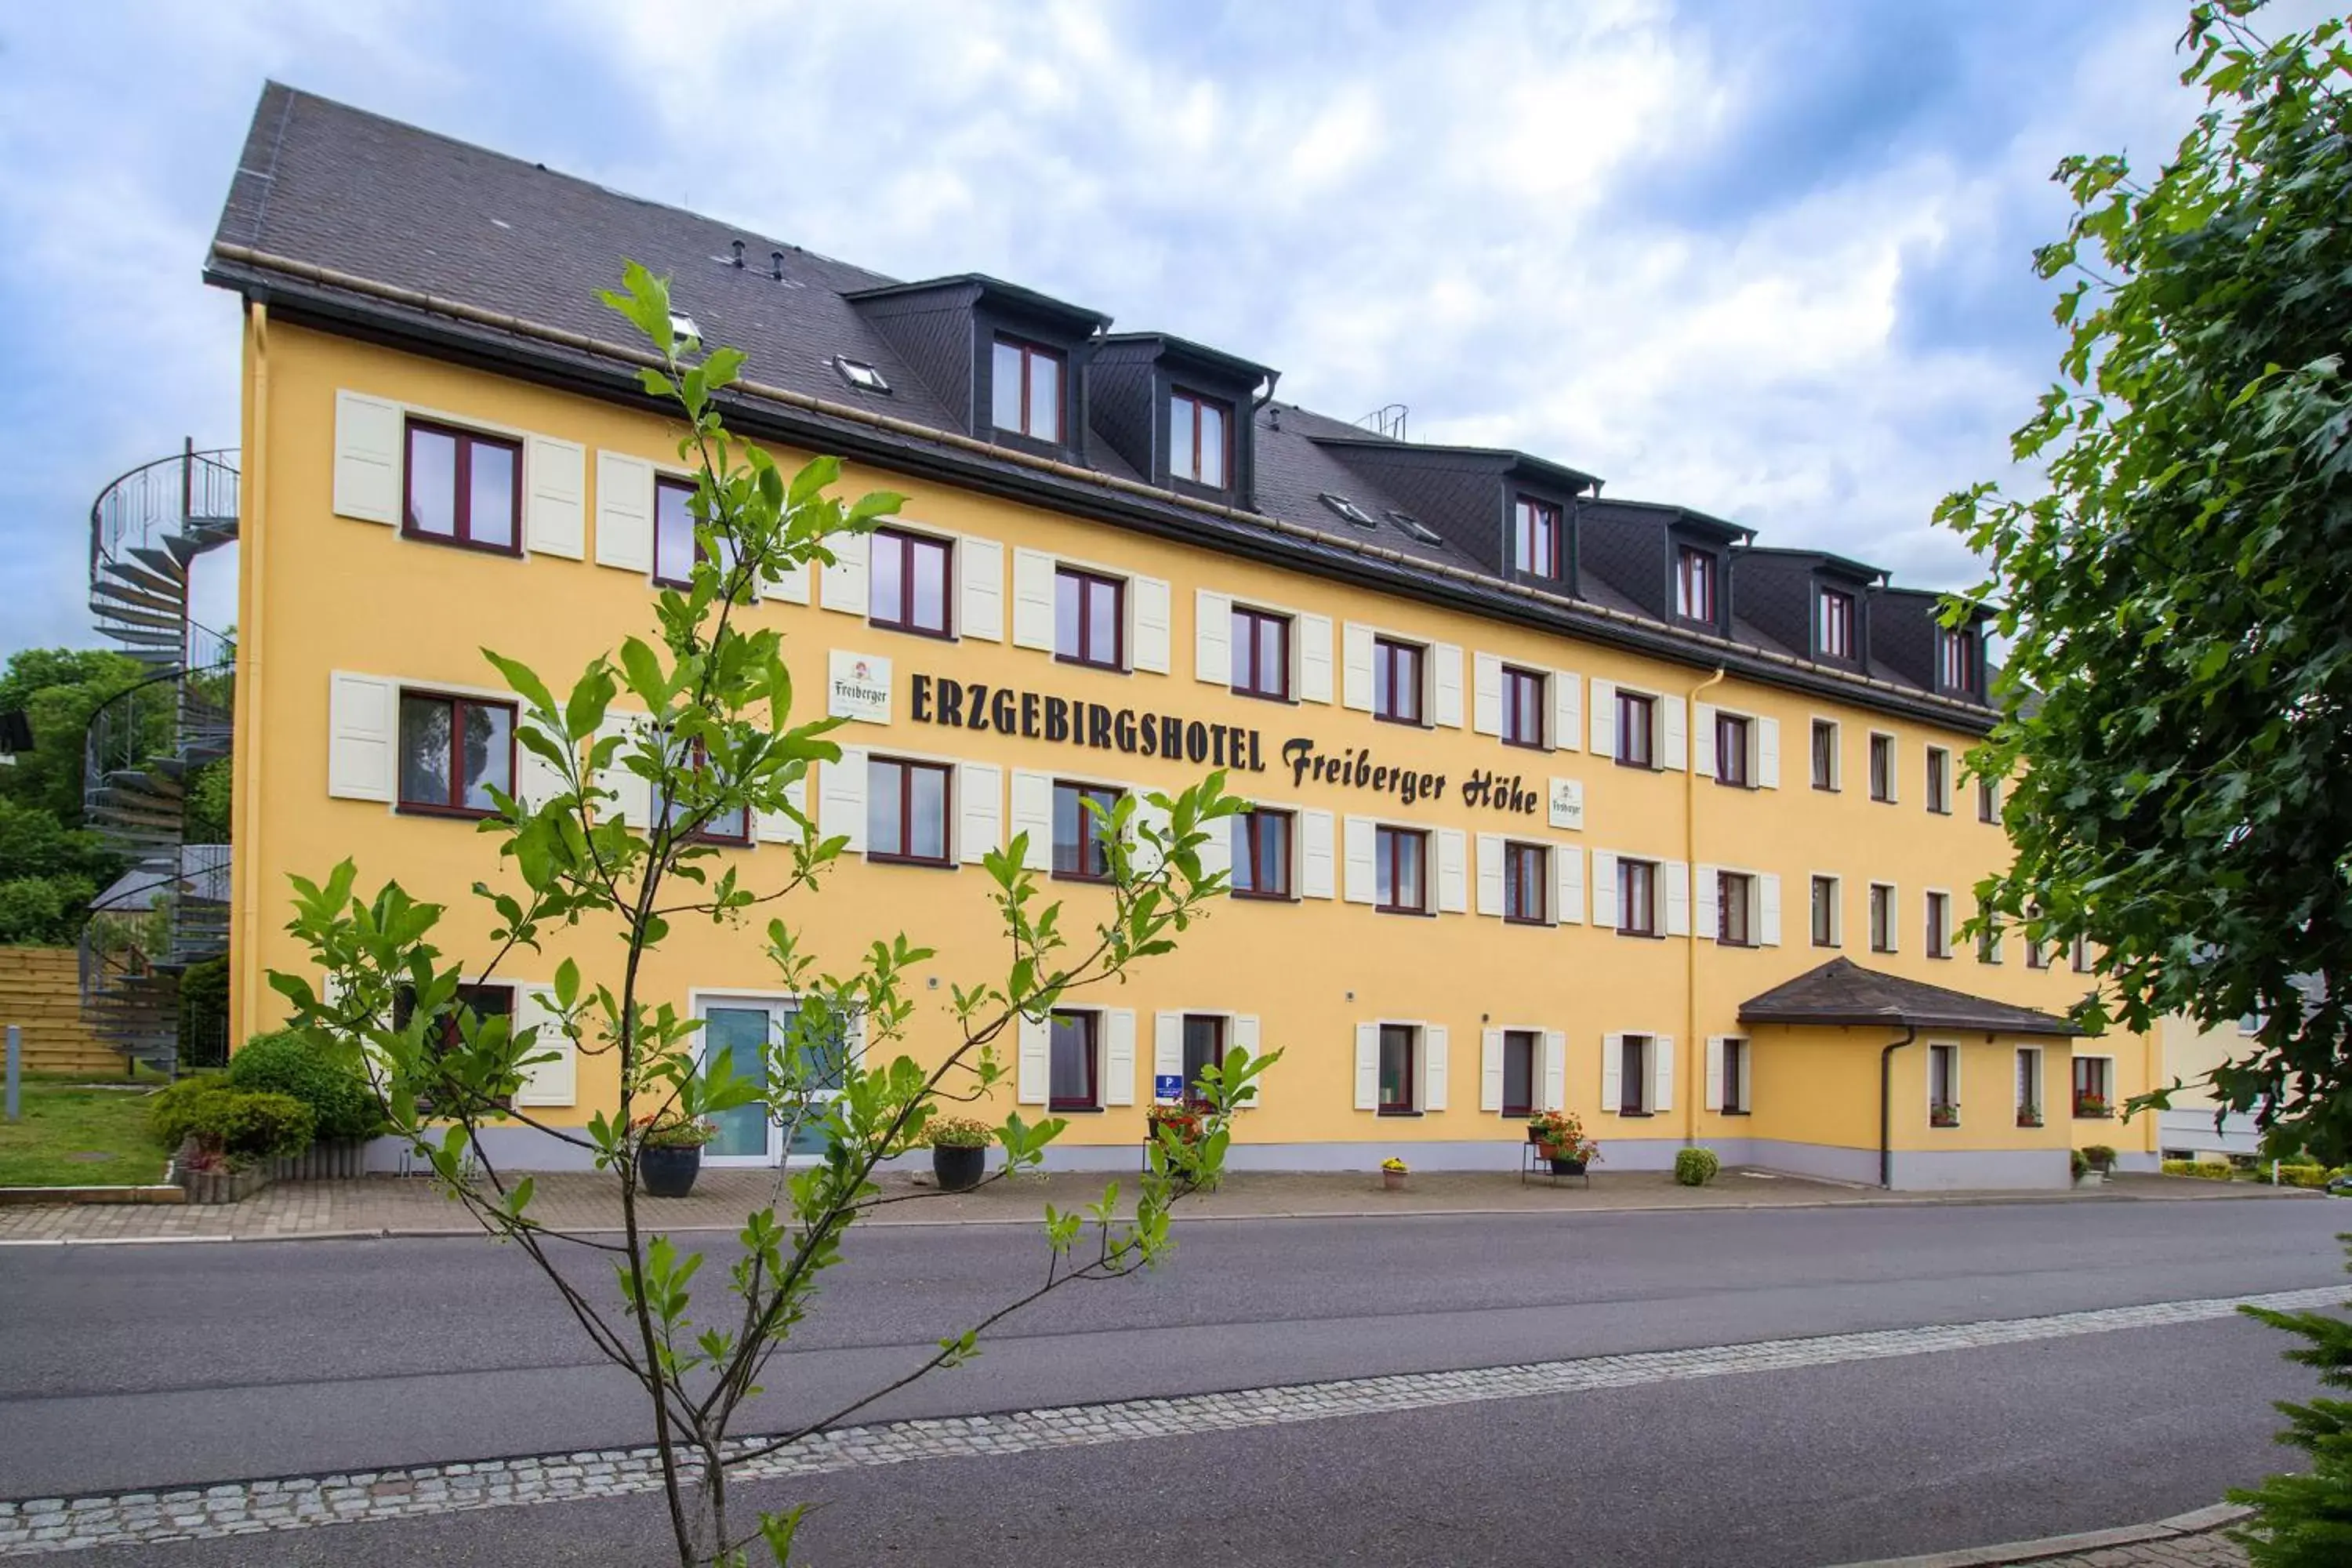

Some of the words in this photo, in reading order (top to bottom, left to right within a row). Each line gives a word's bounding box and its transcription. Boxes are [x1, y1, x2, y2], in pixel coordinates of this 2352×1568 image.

[834, 680, 887, 705] Freiberger
[911, 673, 1267, 772] ERZGEBIRGSHOTEL
[1282, 738, 1446, 805] Freiberger
[1461, 768, 1538, 815] Höhe
[1166, 1076, 1173, 1087] P
